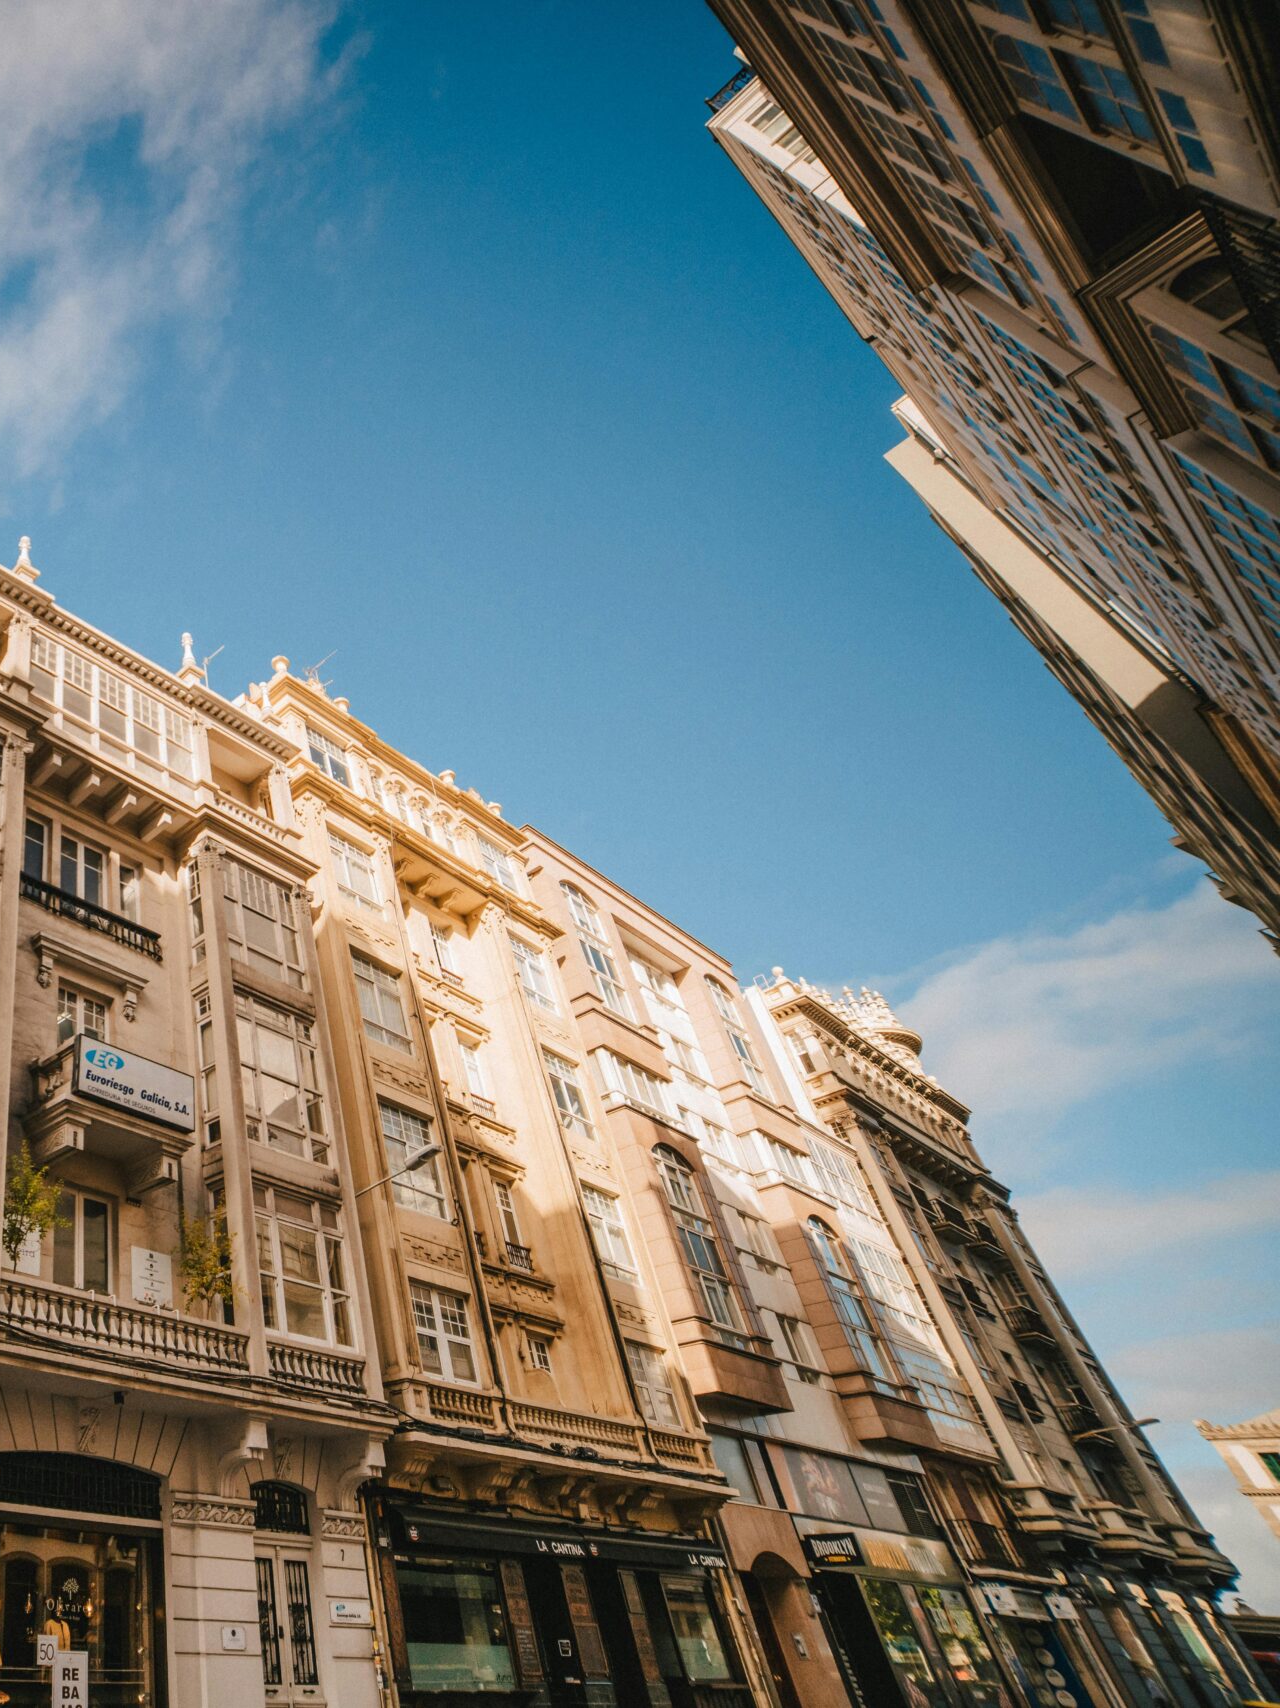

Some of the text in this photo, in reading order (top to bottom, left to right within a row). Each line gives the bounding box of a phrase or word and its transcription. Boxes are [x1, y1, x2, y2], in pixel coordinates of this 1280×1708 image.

[91, 1048, 119, 1071] EG
[85, 1069, 191, 1117] Euroriesgo Galicia, S.A.
[123, 1096, 132, 1106] DE
[535, 1539, 586, 1556] LA CANTINA
[810, 1536, 857, 1558] BROOKLYN
[687, 1553, 727, 1568] LA CANTINA
[39, 1643, 55, 1661] 50
[62, 1667, 80, 1681] RE
[61, 1685, 80, 1700] BA
